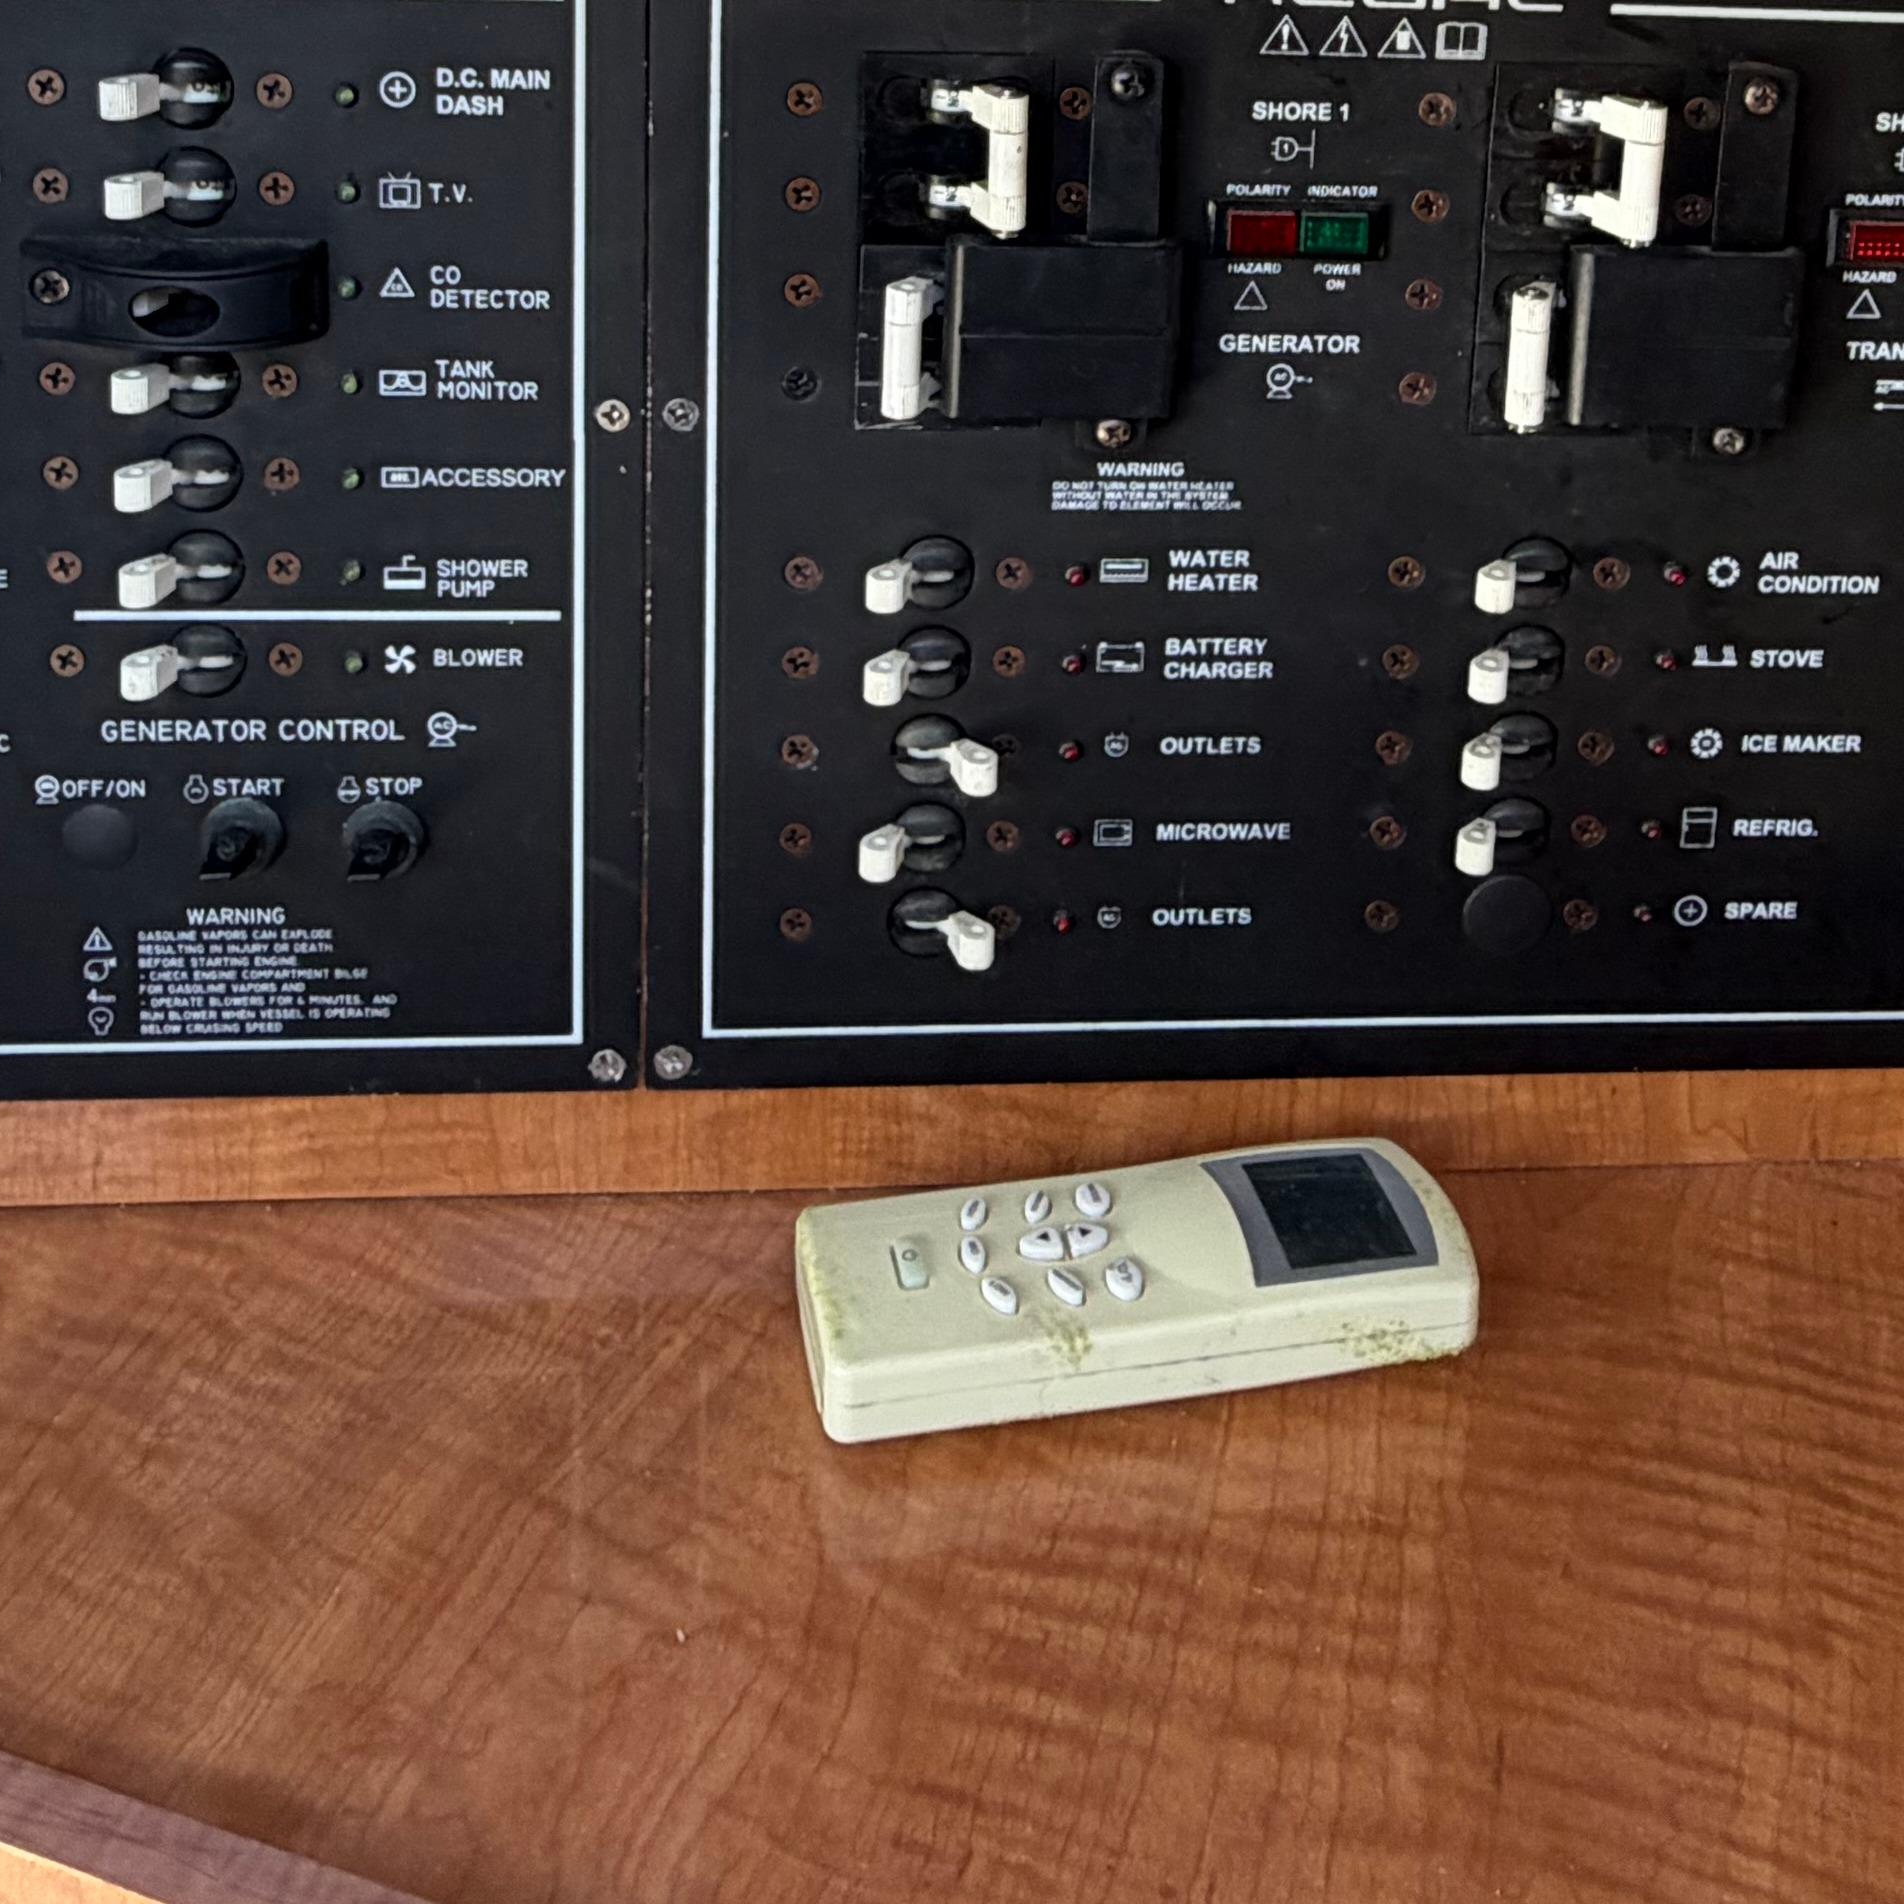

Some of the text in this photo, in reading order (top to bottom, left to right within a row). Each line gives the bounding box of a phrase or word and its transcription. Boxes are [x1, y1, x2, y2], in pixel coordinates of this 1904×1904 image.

[435, 67, 551, 90] D.C. MAIN
[436, 95, 504, 116] DASH
[1251, 100, 1350, 122] SHORE 1
[428, 182, 474, 204] T.V.
[1226, 183, 1378, 197] POLARITY INDICATOR
[429, 265, 462, 286] CO
[1227, 262, 1362, 276] HAZARD POWER
[1842, 270, 1897, 284] HAZARD
[1325, 278, 1346, 292] ON
[430, 288, 551, 311] DETECTOR
[1218, 333, 1361, 355] GENERATOR
[434, 358, 495, 379] TANK
[436, 380, 539, 402] MONITOR
[421, 467, 567, 488] ACCESSORY
[1096, 461, 1185, 478] WARNING
[1071, 481, 1235, 492] NOT TURN WATER HEATER
[1051, 500, 1242, 511] DAMAGE ELEMENT OCCUR
[436, 558, 529, 579] SHOWER
[1168, 549, 1250, 569] WATER
[1759, 551, 1800, 571] AIR
[436, 579, 496, 599] PUMP
[1167, 572, 1259, 593] HEATER
[1757, 574, 1881, 595] CONDITION
[1164, 636, 1268, 657] BATTERY
[432, 648, 524, 667] BLOWER
[1749, 649, 1825, 669] STOVE
[1163, 660, 1274, 680] CHARGER
[100, 718, 405, 744] GENERATOR CONTROL
[1159, 735, 1263, 756] OUTLETS
[1741, 734, 1863, 754] ICE MAKER
[61, 778, 147, 800] OFF/ON
[211, 777, 286, 796] START
[364, 776, 424, 796] STOP
[1155, 821, 1292, 842] MICROWAVE
[1732, 818, 1819, 838] REFRIG.
[186, 906, 286, 926] WARNING
[1151, 906, 1253, 927] OUTLETS
[1724, 901, 1799, 921] SPARE
[137, 930, 197, 942] GASOLINE
[201, 929, 248, 941] VAPORS
[252, 929, 278, 940] CAN
[137, 957, 185, 969] BEFORE
[138, 984, 163, 995] FOR
[231, 982, 278, 993] VAPORS
[281, 982, 307, 993] AND
[150, 993, 398, 1008] OPERATE FOR AND
[140, 1021, 284, 1036] BELOW SPEED
